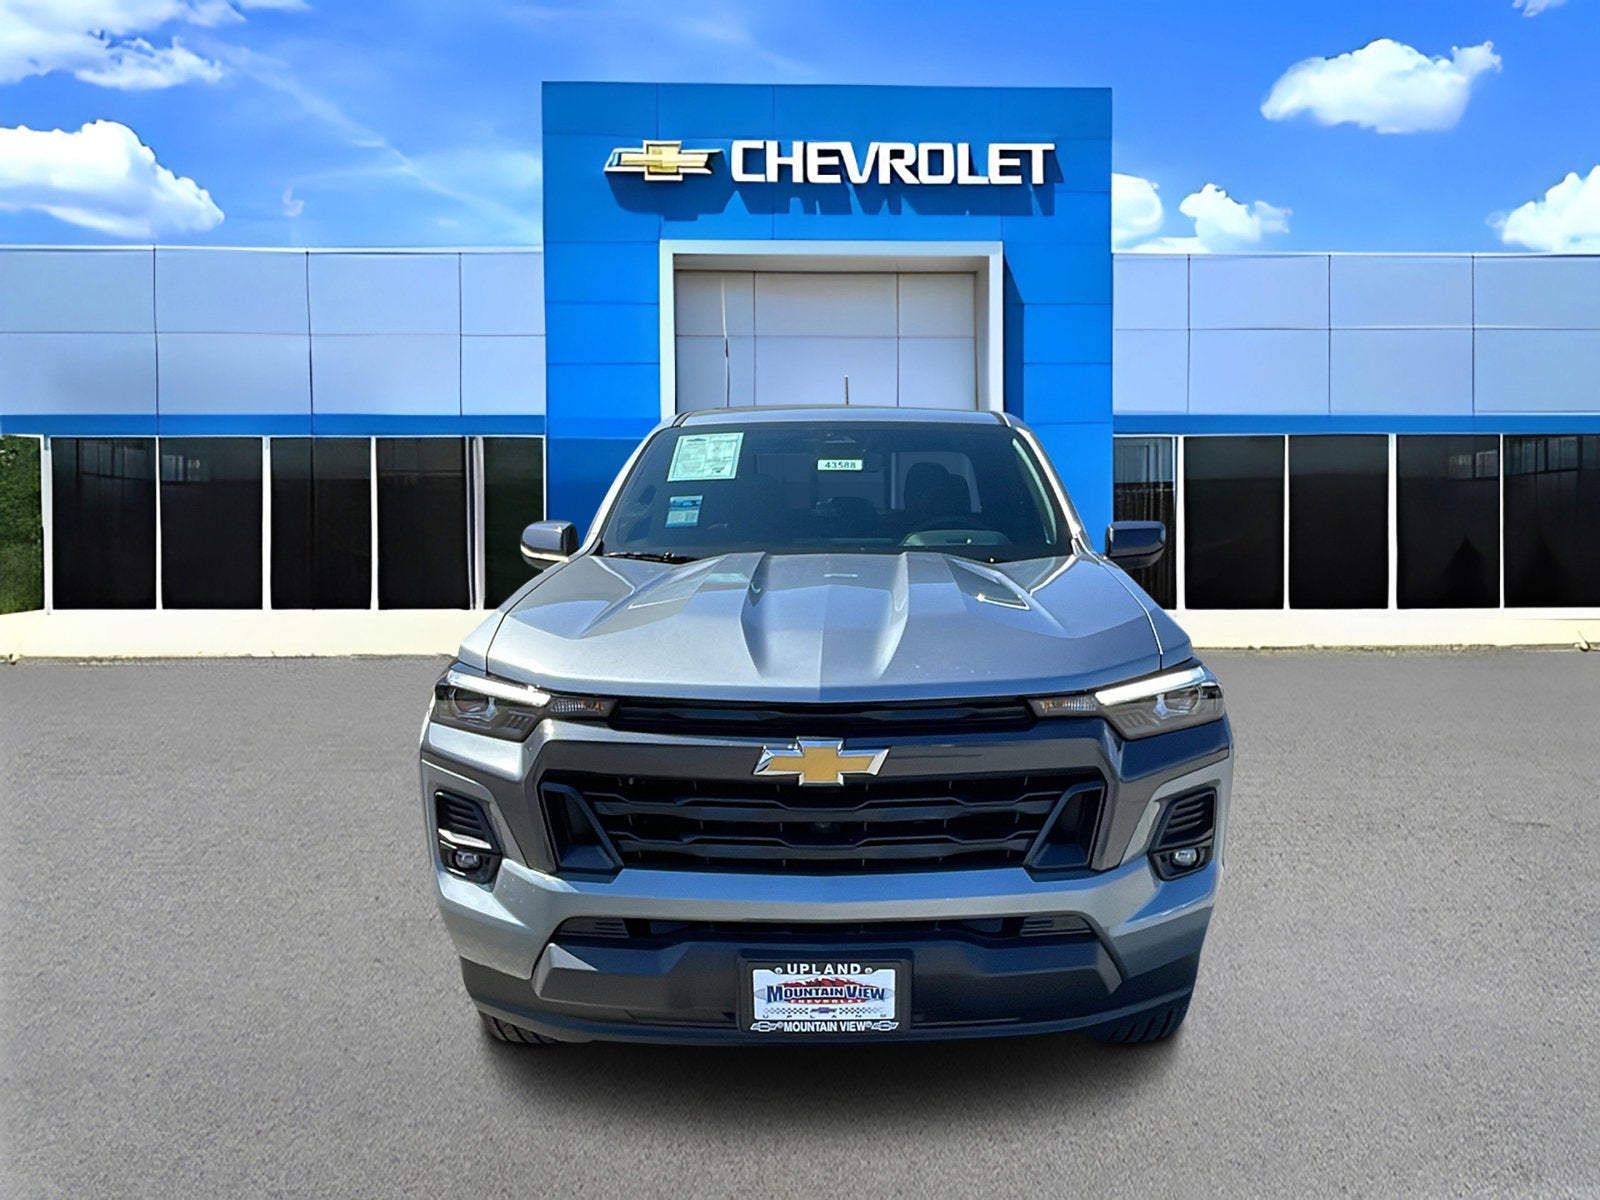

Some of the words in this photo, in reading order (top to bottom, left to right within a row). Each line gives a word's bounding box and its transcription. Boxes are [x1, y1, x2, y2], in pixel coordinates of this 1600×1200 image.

[731, 140, 1056, 186] CHEVROLET
[786, 963, 861, 975] UPLAND
[766, 985, 844, 1003] MOUNTAIN
[845, 985, 885, 1001] VIEW
[783, 1021, 838, 1032] MOUNTAIN
[839, 1021, 866, 1032] VIEW
